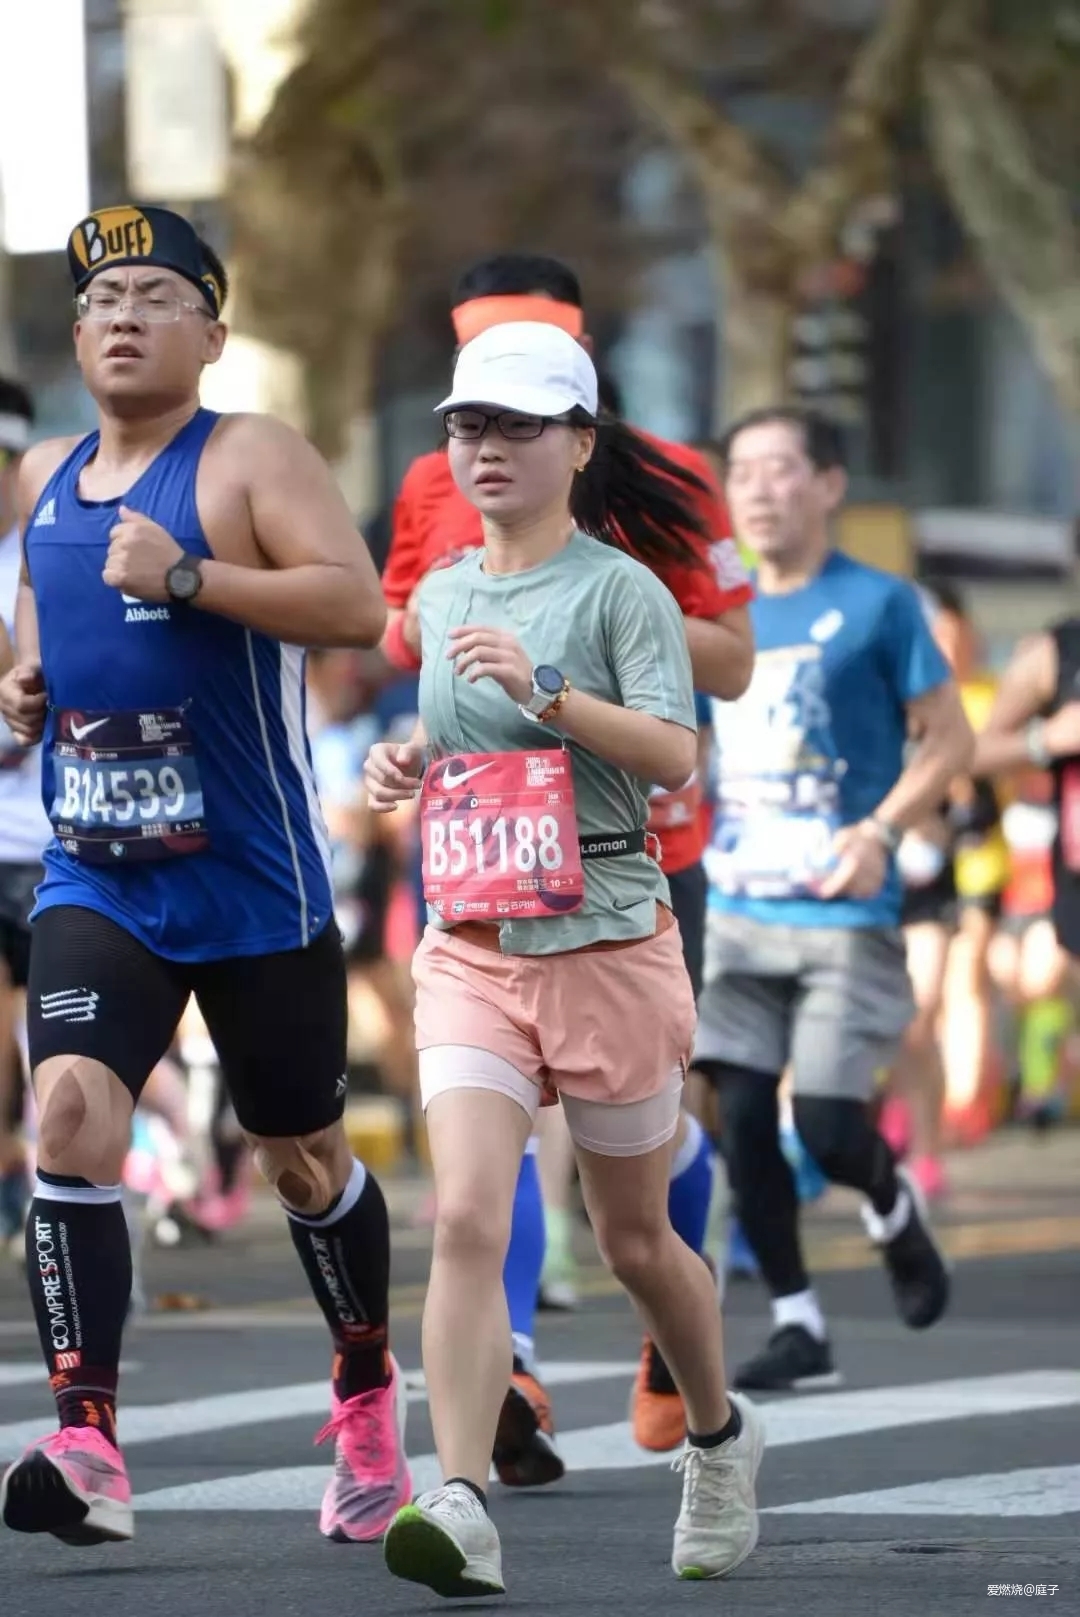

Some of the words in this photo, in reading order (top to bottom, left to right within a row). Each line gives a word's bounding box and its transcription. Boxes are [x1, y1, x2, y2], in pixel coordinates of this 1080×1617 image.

[80, 217, 147, 267] BUFF
[124, 607, 170, 622] Abbott
[60, 766, 185, 822] B14539
[429, 815, 563, 876] B51188
